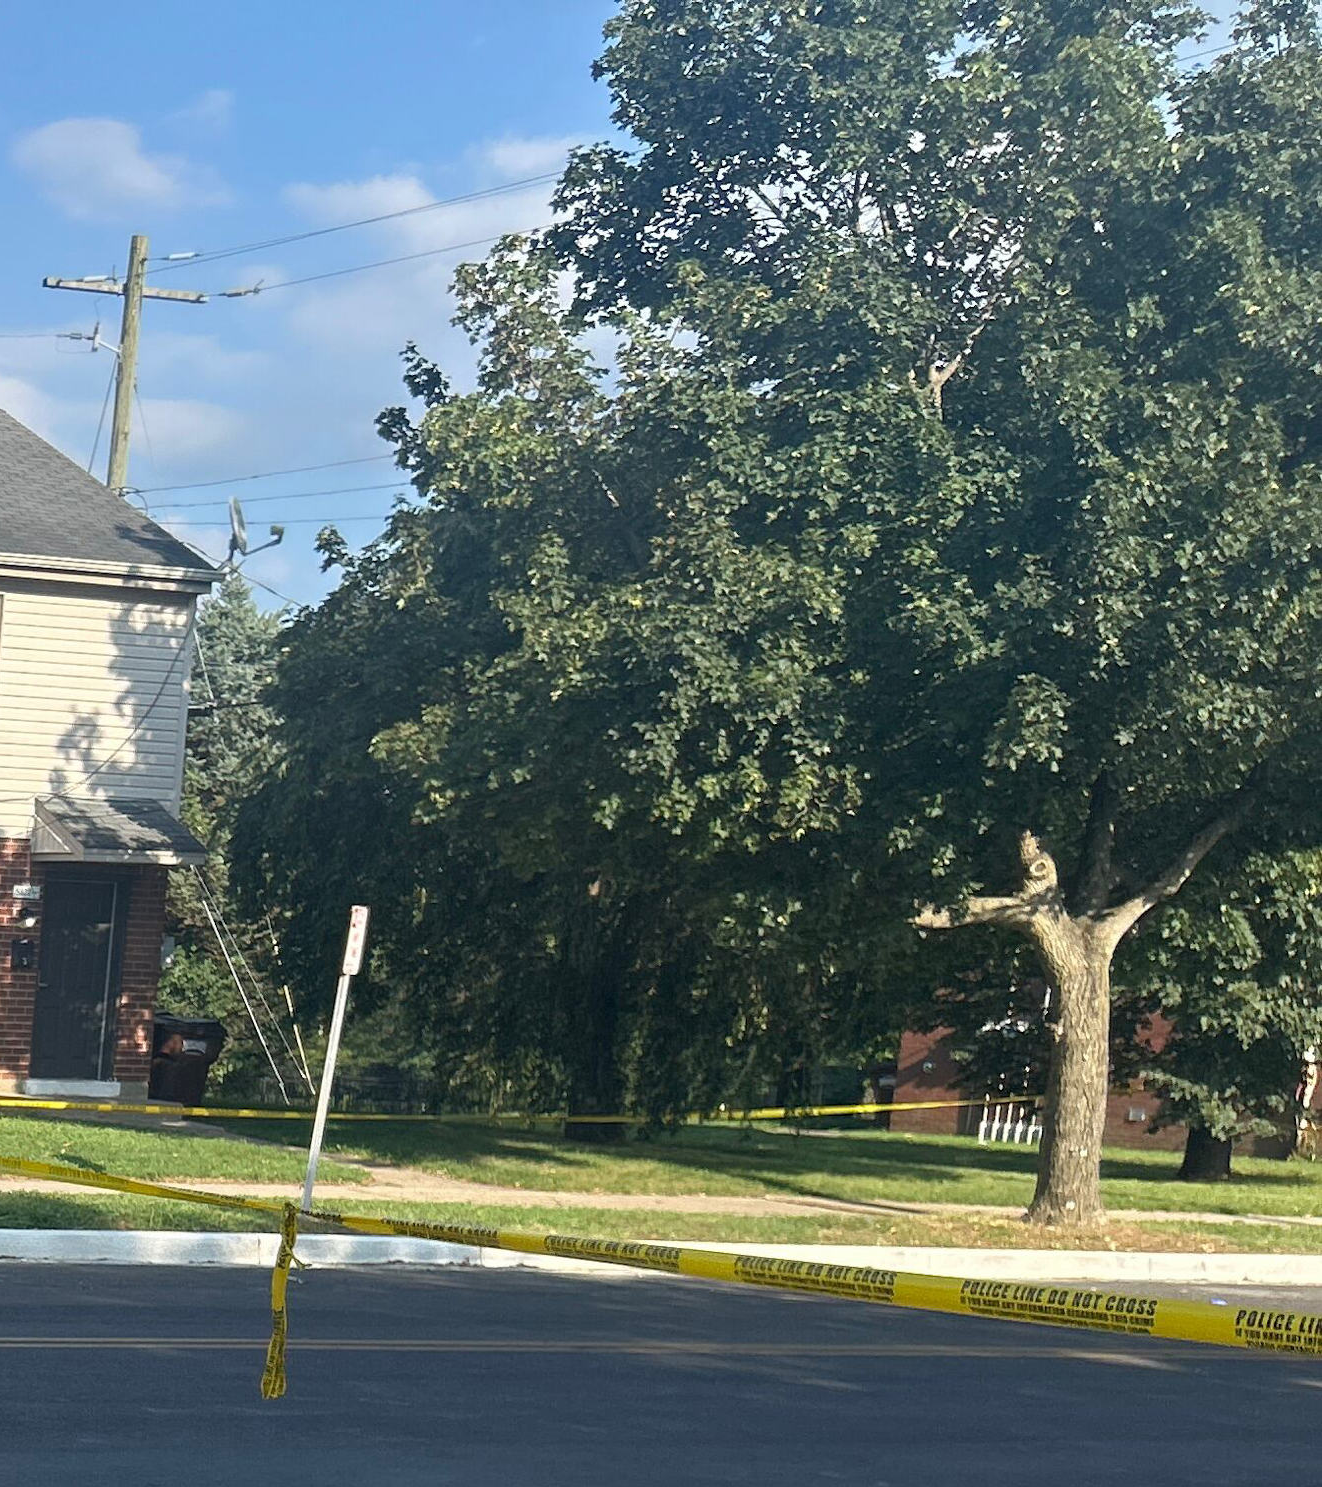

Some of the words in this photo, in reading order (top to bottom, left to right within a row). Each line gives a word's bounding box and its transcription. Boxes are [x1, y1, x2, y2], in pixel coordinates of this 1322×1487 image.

[960, 1280, 1010, 1298] POLICE
[1013, 1285, 1045, 1303] LINE
[1047, 1289, 1069, 1306] DO
[1072, 1292, 1104, 1309] NOT
[1105, 1295, 1158, 1316] CROSS
[1235, 1309, 1295, 1331] POLICE
